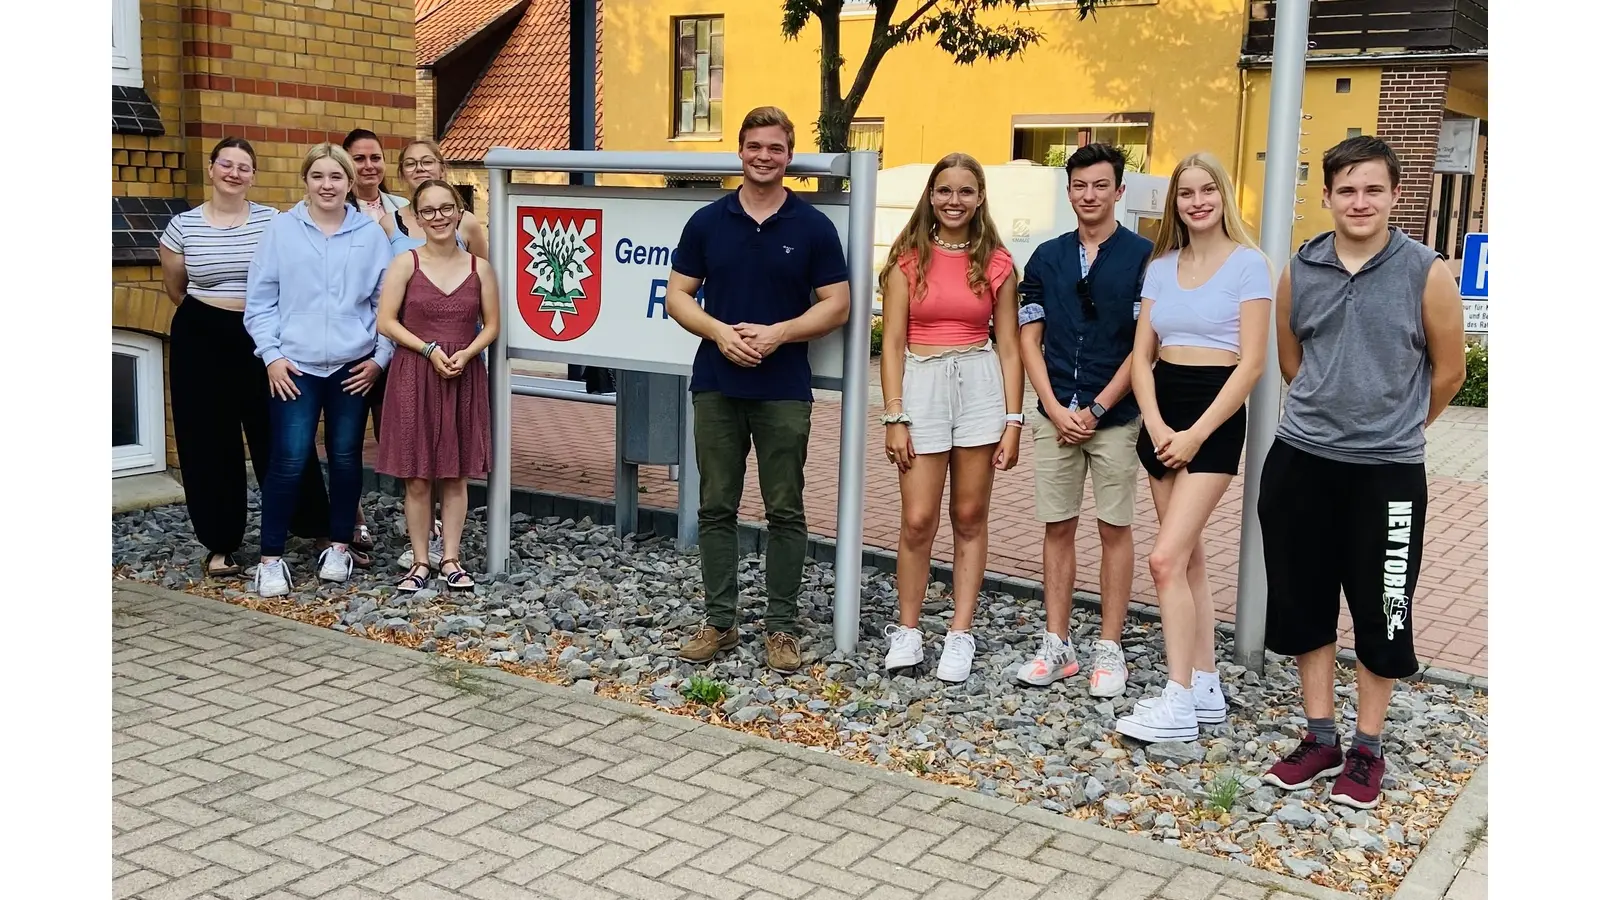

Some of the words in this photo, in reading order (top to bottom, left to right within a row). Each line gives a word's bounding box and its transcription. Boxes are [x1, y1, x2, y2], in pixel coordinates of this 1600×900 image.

[615, 237, 680, 266] Gem
[1388, 501, 1412, 544] NEW
[1383, 545, 1409, 602] YORK
